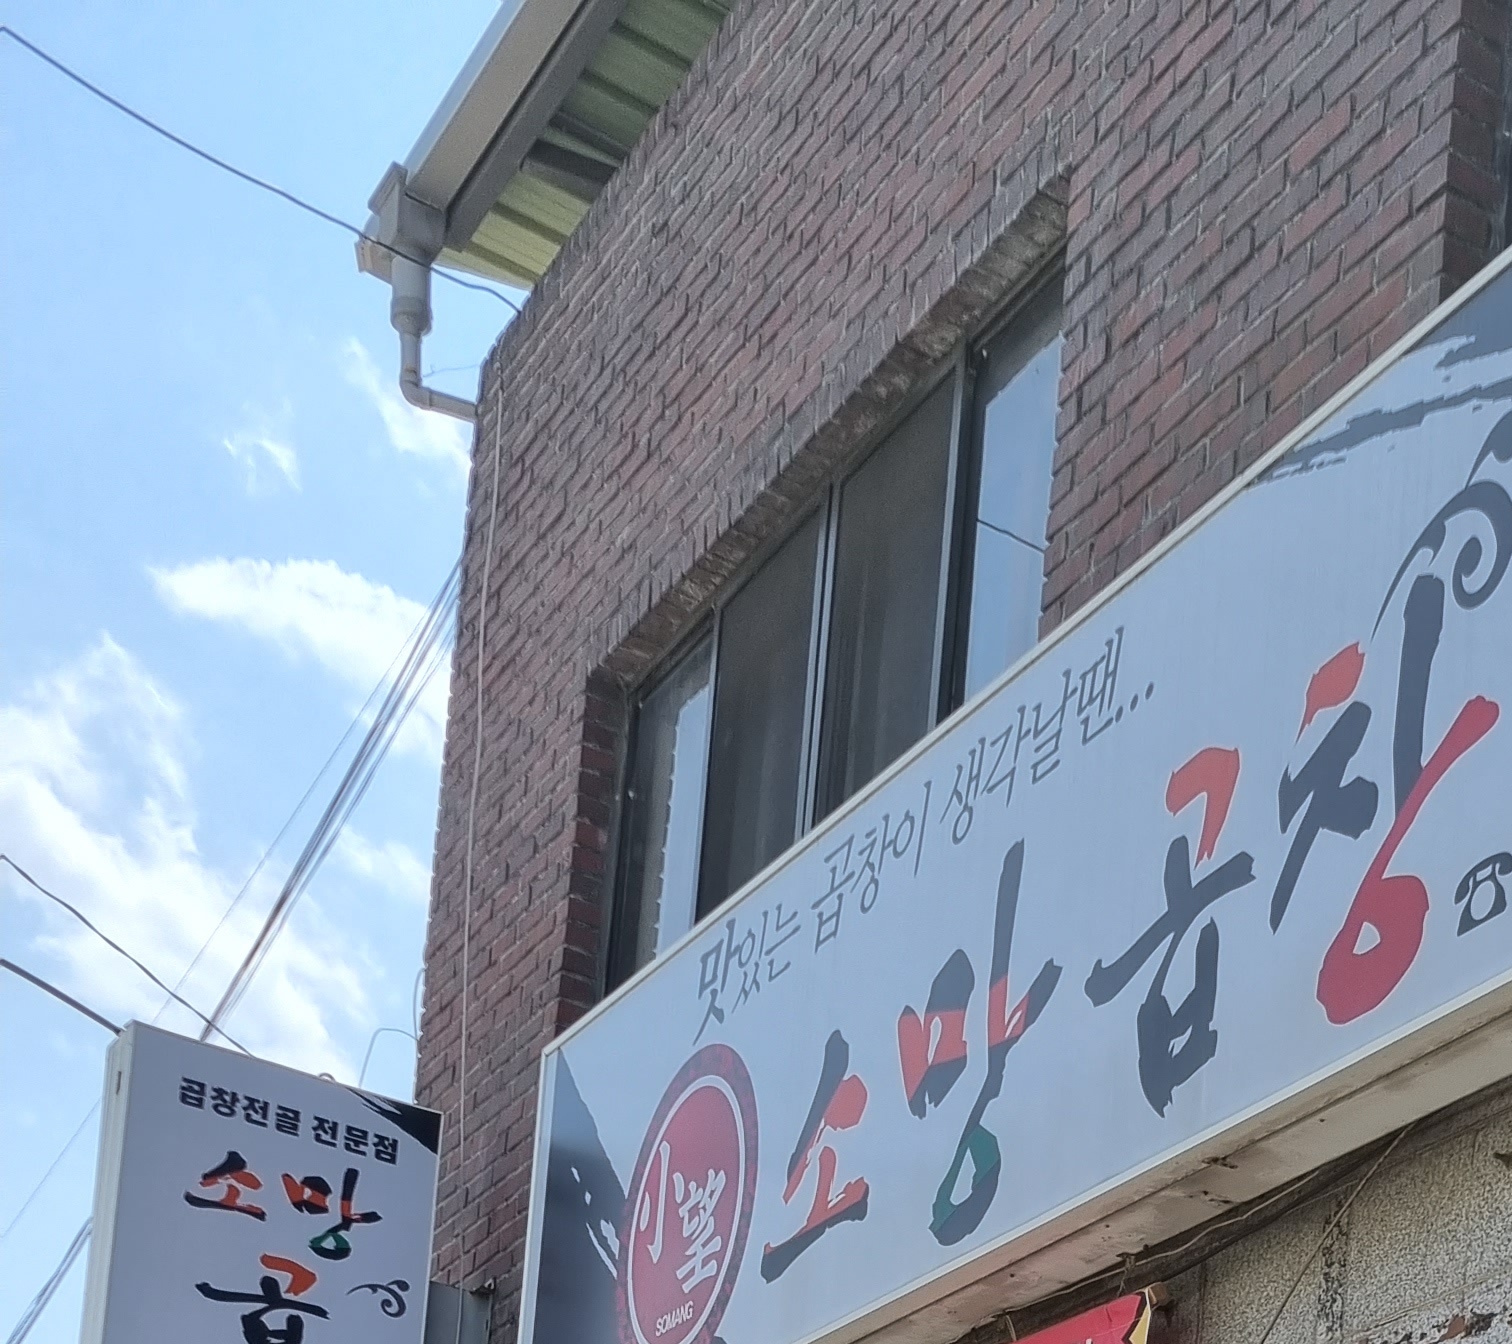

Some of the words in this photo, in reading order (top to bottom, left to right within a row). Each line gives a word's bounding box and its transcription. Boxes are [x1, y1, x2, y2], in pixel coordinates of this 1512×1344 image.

[693, 919, 801, 1046] 맛있는
[811, 781, 931, 954] 곱창이
[178, 1075, 302, 1138] 곱창전골
[310, 1115, 400, 1166] 전문점
[183, 1150, 383, 1260] 소망
[655, 1301, 694, 1337] SOMANG
